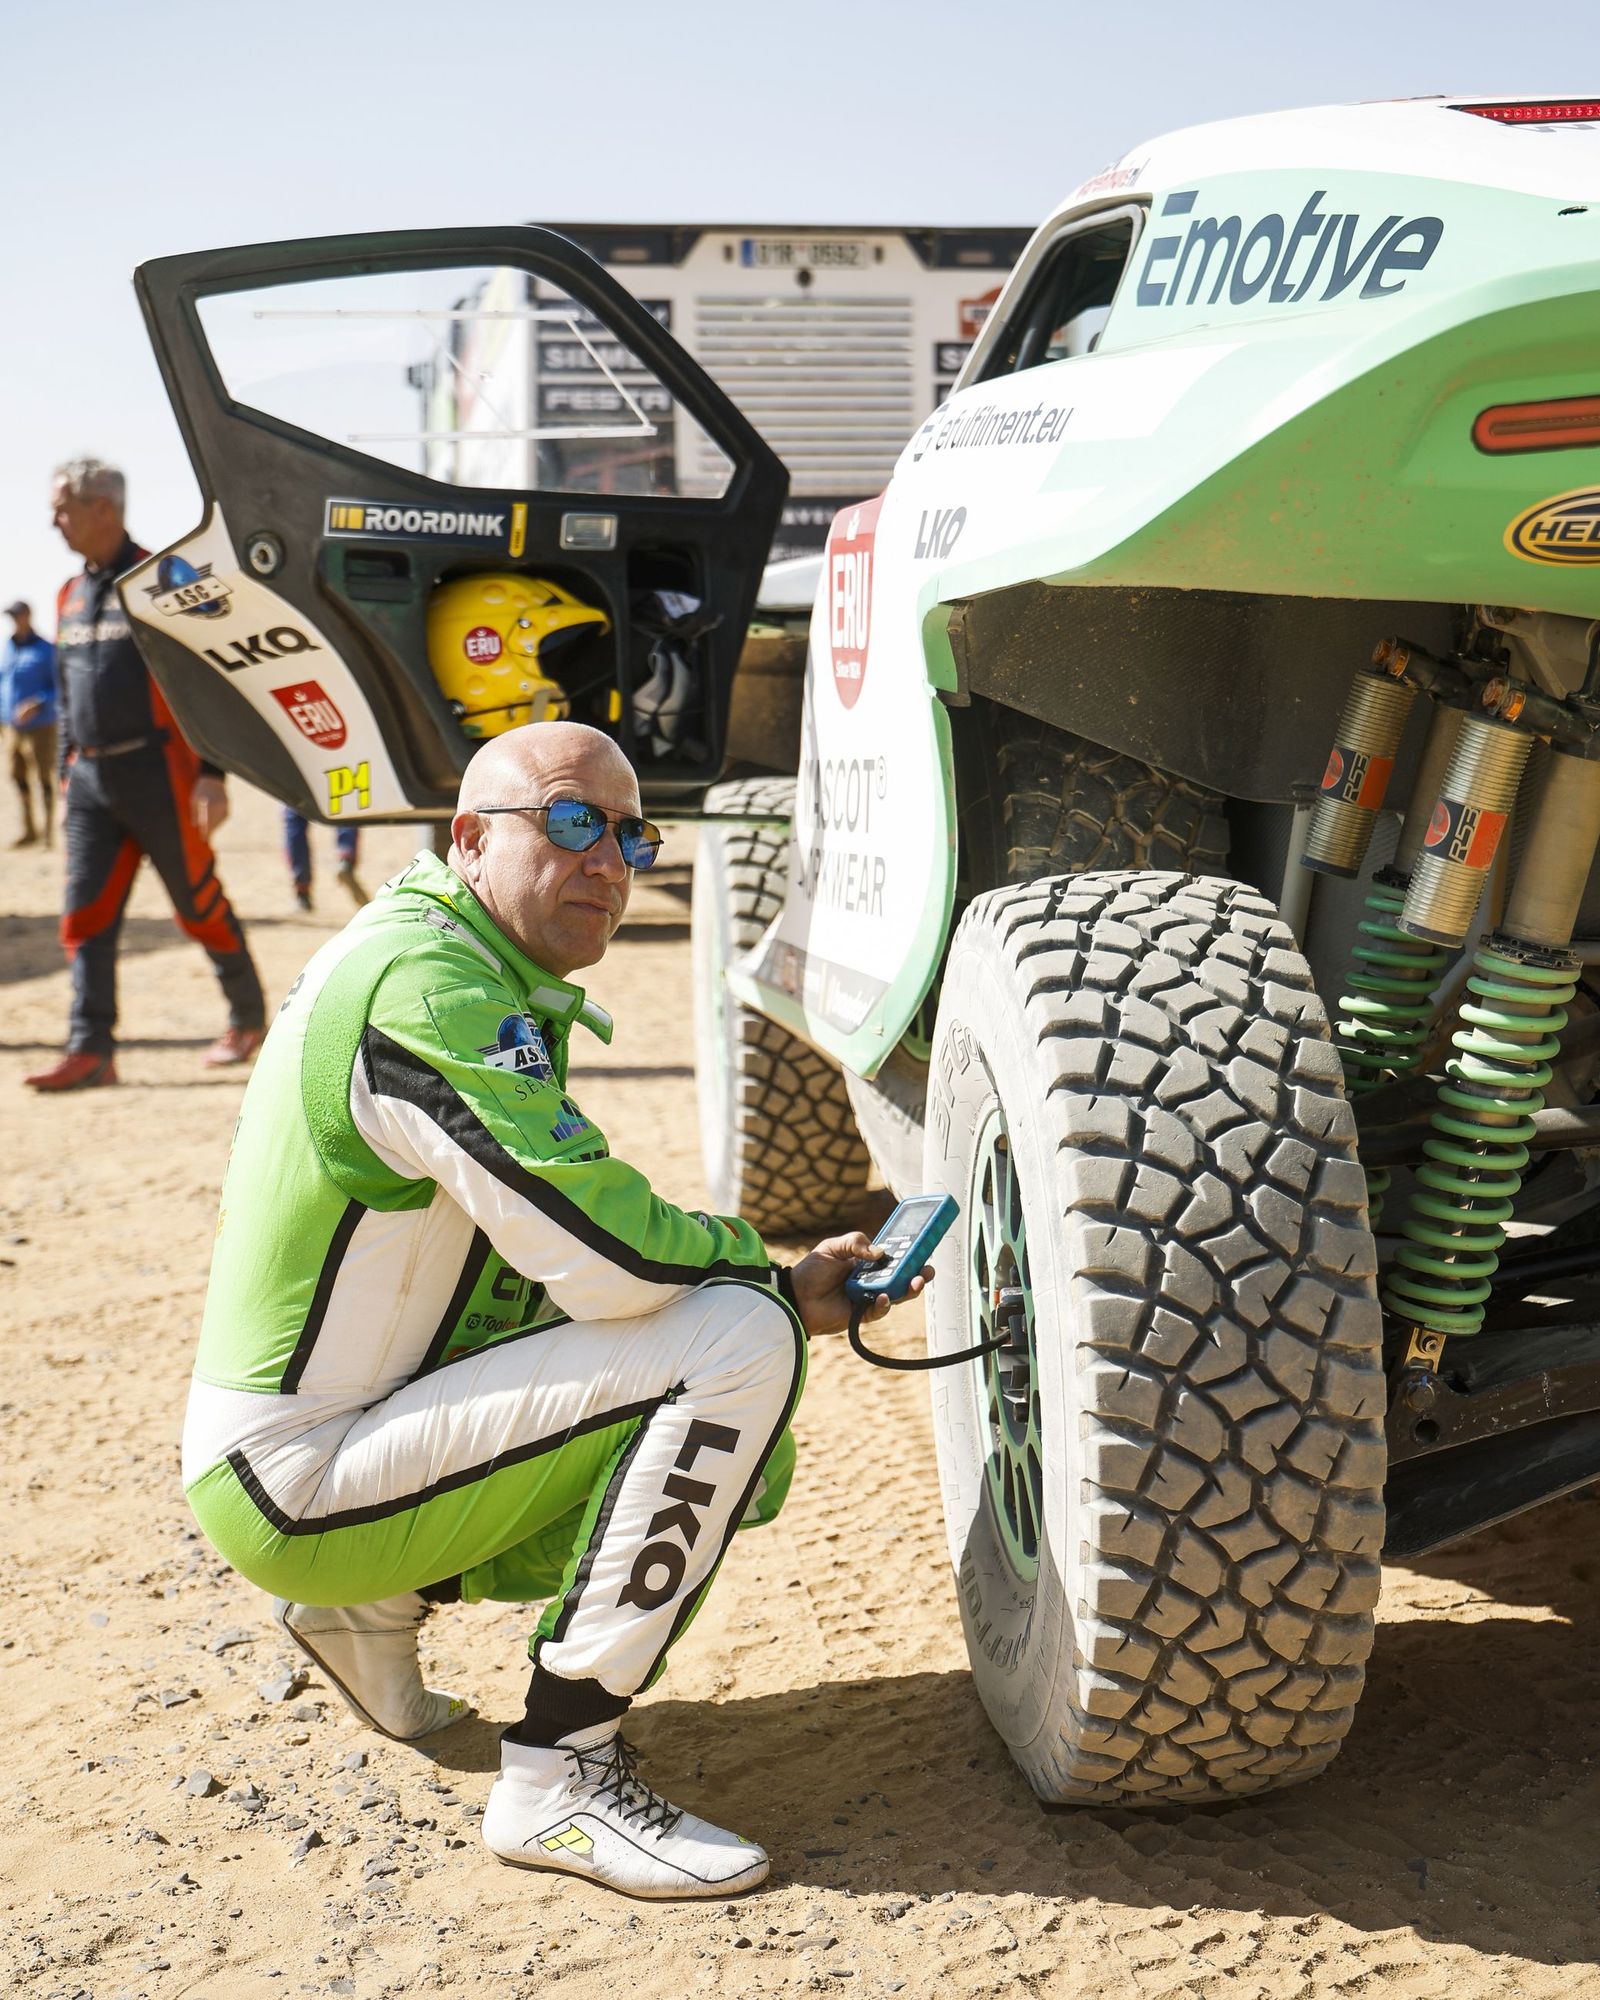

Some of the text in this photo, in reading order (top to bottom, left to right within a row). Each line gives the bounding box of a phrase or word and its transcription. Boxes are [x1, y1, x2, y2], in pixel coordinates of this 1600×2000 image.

[1136, 190, 1444, 307] Emotive
[364, 507, 505, 537] ROORDINK
[913, 506, 967, 560] LKQ
[173, 585, 210, 609] ASC
[832, 551, 870, 650] ERU
[203, 626, 322, 673] LKQ
[466, 636, 501, 658] ERU
[288, 698, 343, 738] ERU
[325, 761, 370, 815] P1
[615, 1418, 742, 1612] LKQ
